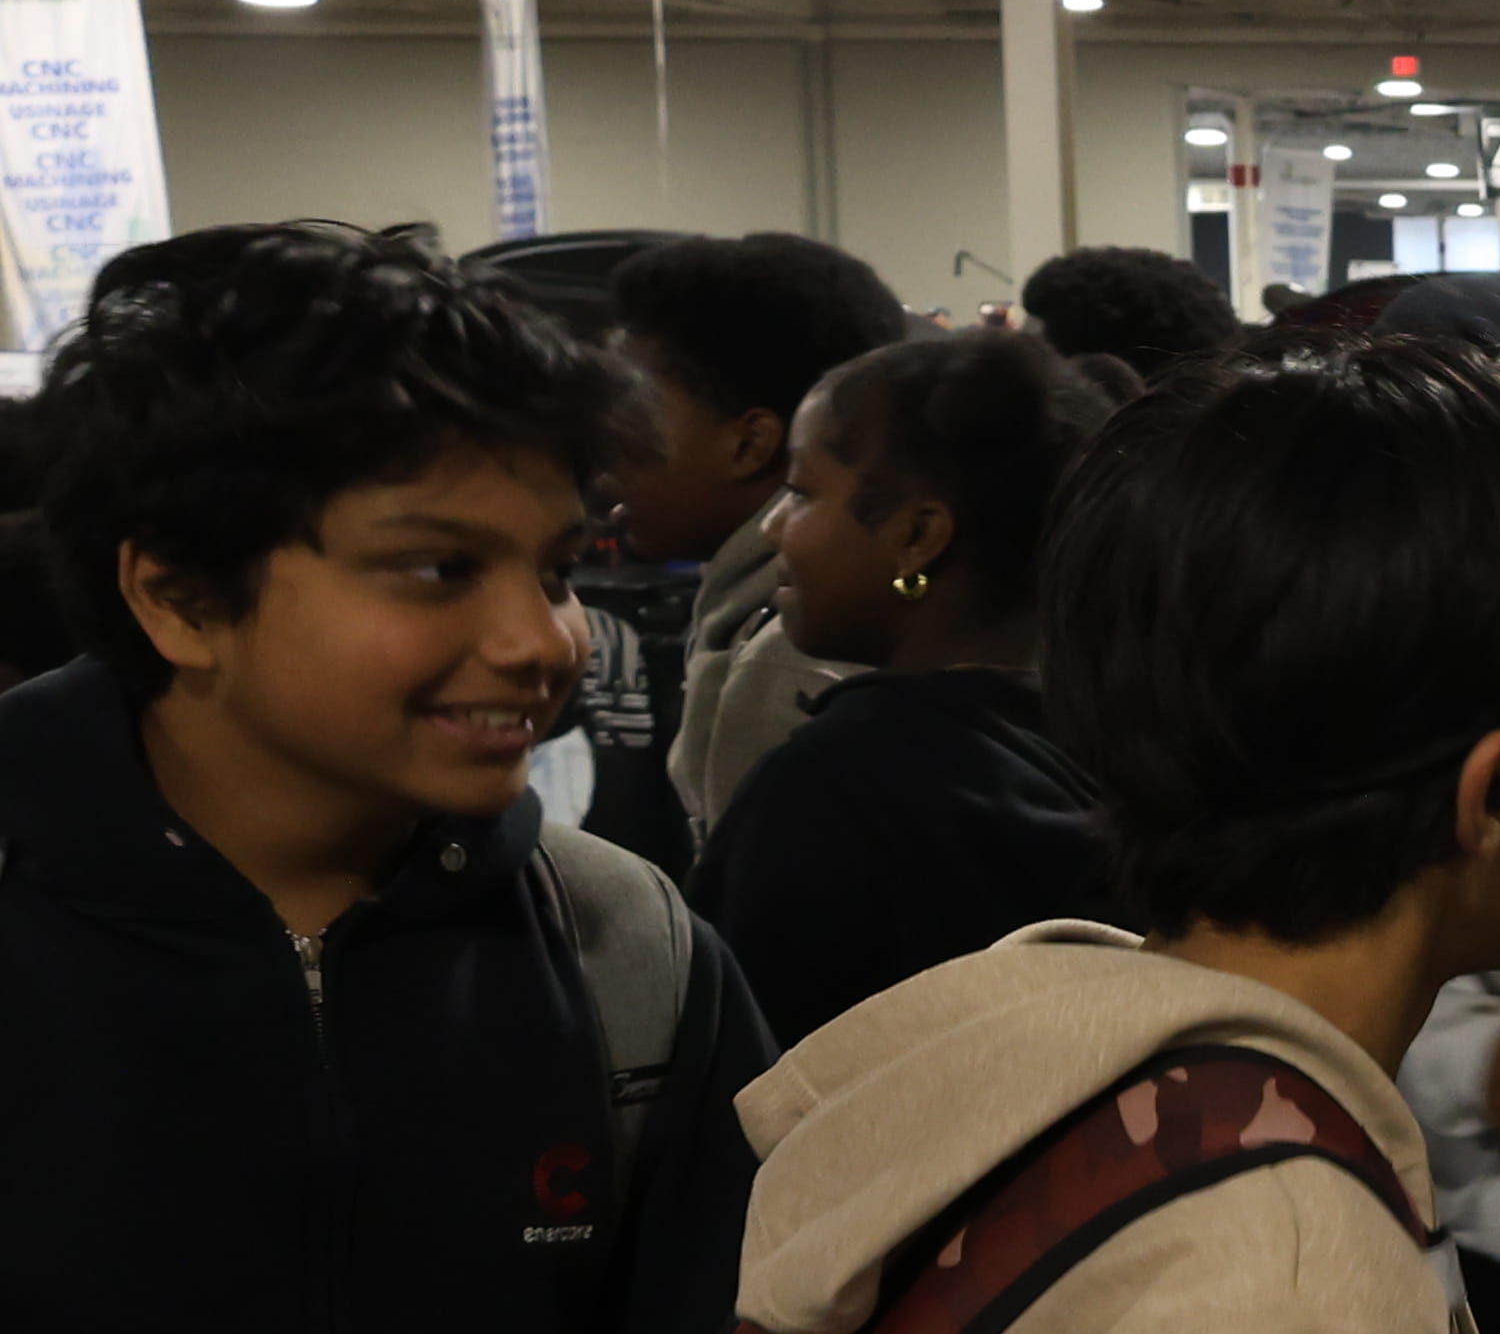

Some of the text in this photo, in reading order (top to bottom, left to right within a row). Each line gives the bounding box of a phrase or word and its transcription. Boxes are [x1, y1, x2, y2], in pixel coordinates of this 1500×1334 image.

[22, 60, 82, 78] CNC
[31, 121, 89, 140] CNC
[37, 151, 96, 169] CNC
[47, 213, 103, 232] CNC
